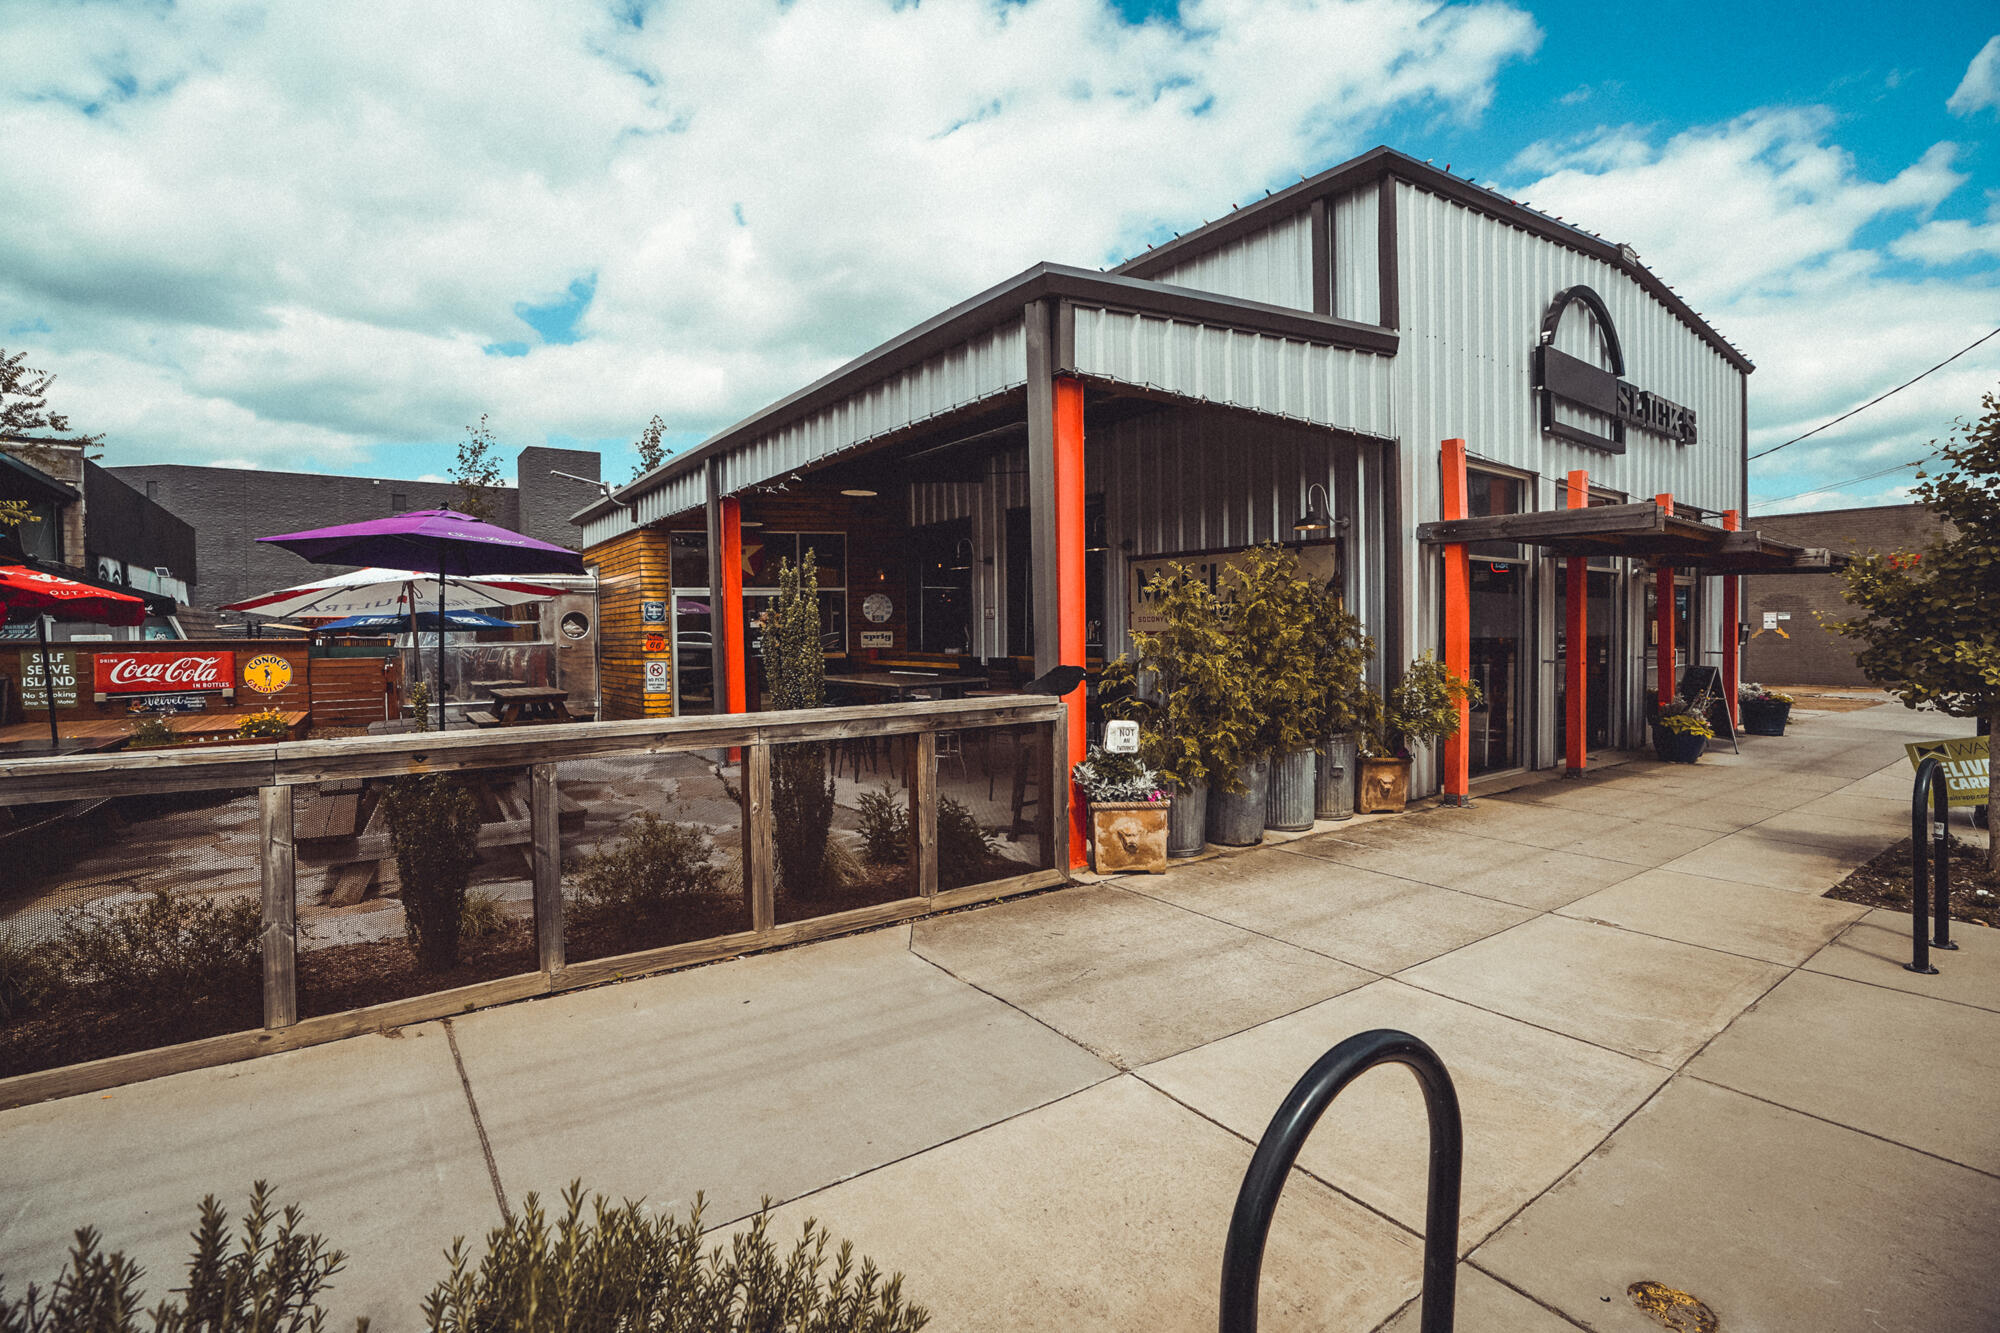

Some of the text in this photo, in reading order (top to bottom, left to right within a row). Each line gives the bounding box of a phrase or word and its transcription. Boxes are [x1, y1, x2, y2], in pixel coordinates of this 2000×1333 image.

[110, 656, 221, 684] Coca-Cola
[248, 656, 288, 670] CONOCO
[247, 679, 287, 692] GASOLINE
[1950, 740, 1990, 756] WAI
[1941, 758, 1990, 778] ELIV
[1949, 775, 1990, 790] CARR
